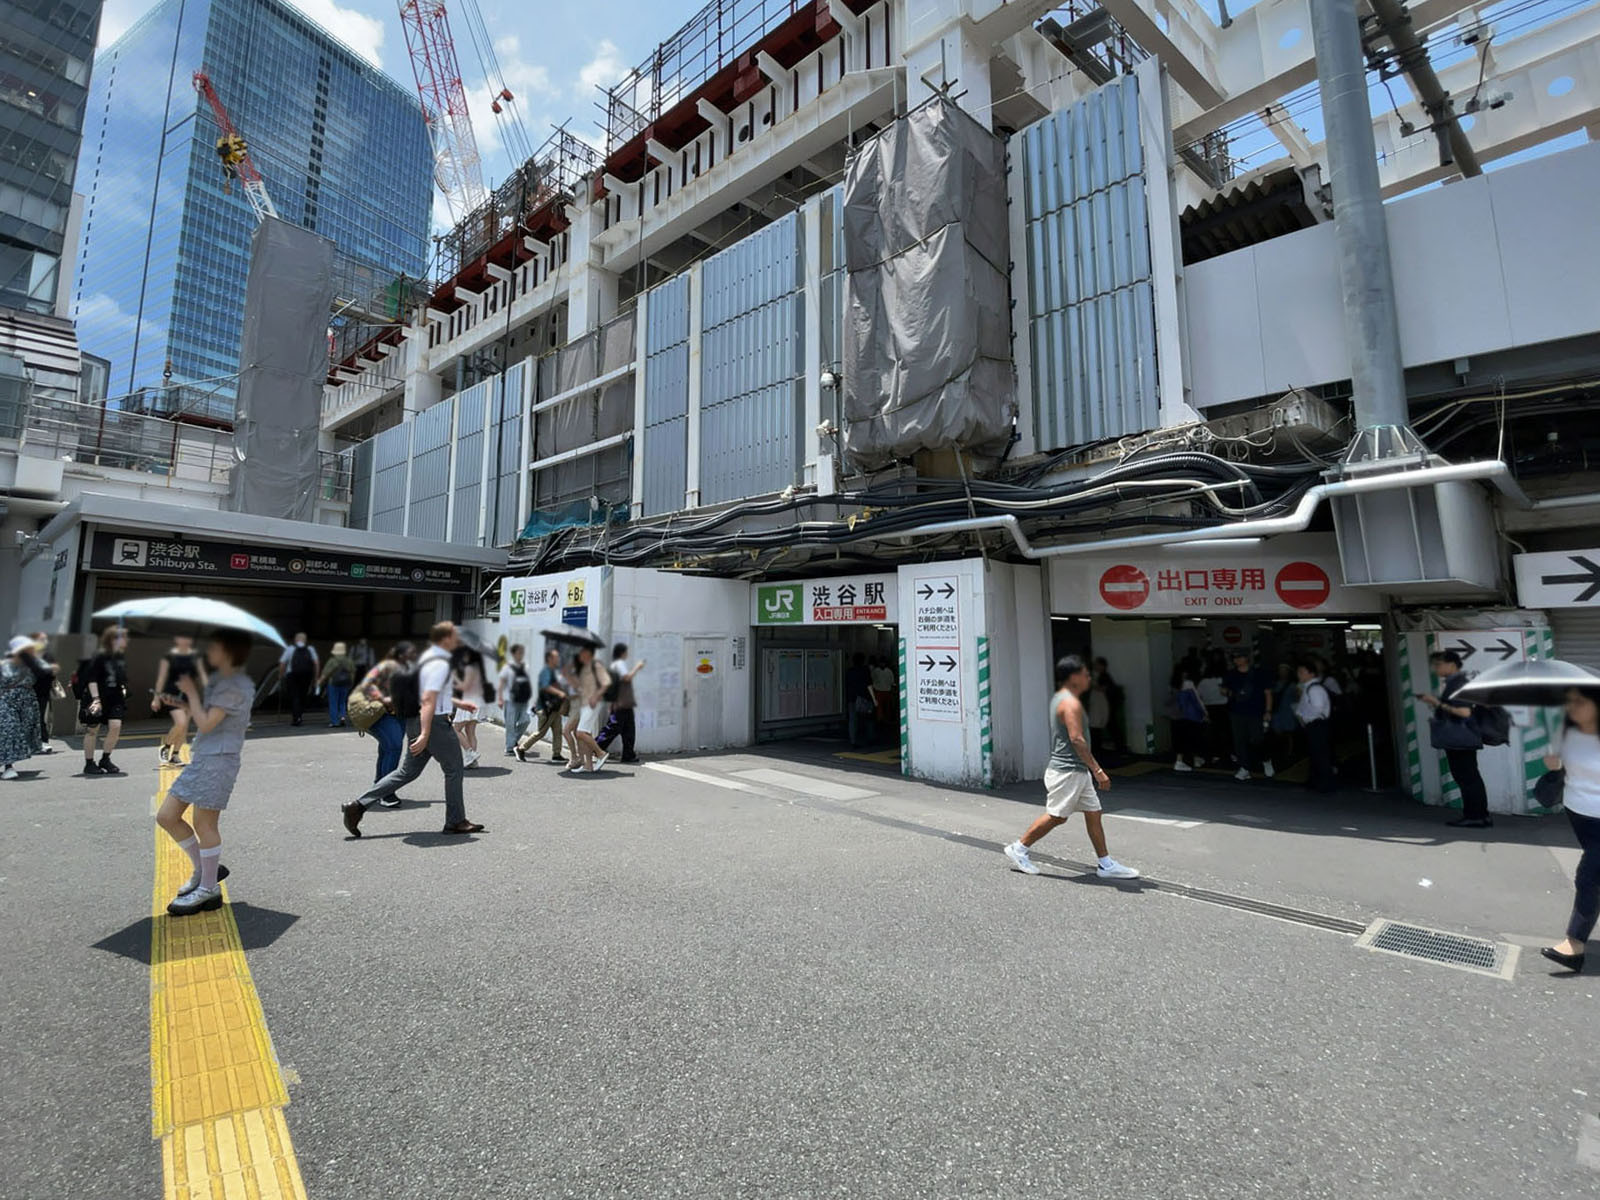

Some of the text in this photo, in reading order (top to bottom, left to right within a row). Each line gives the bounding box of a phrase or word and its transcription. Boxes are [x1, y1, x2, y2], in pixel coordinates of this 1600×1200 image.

[150, 541, 200, 559] 渋谷駅
[149, 557, 218, 571] Shibuya Sta.
[1157, 568, 1265, 591] 出口専用
[511, 590, 525, 608] JR
[527, 589, 548, 605] 渋谷駅
[765, 589, 794, 612] JR
[812, 582, 885, 607] 渋谷駅
[1184, 597, 1244, 606] EXIT ONLY
[815, 608, 854, 620] 入口専用
[917, 624, 957, 632] ご利用ください
[918, 696, 959, 706] ご利用ください
